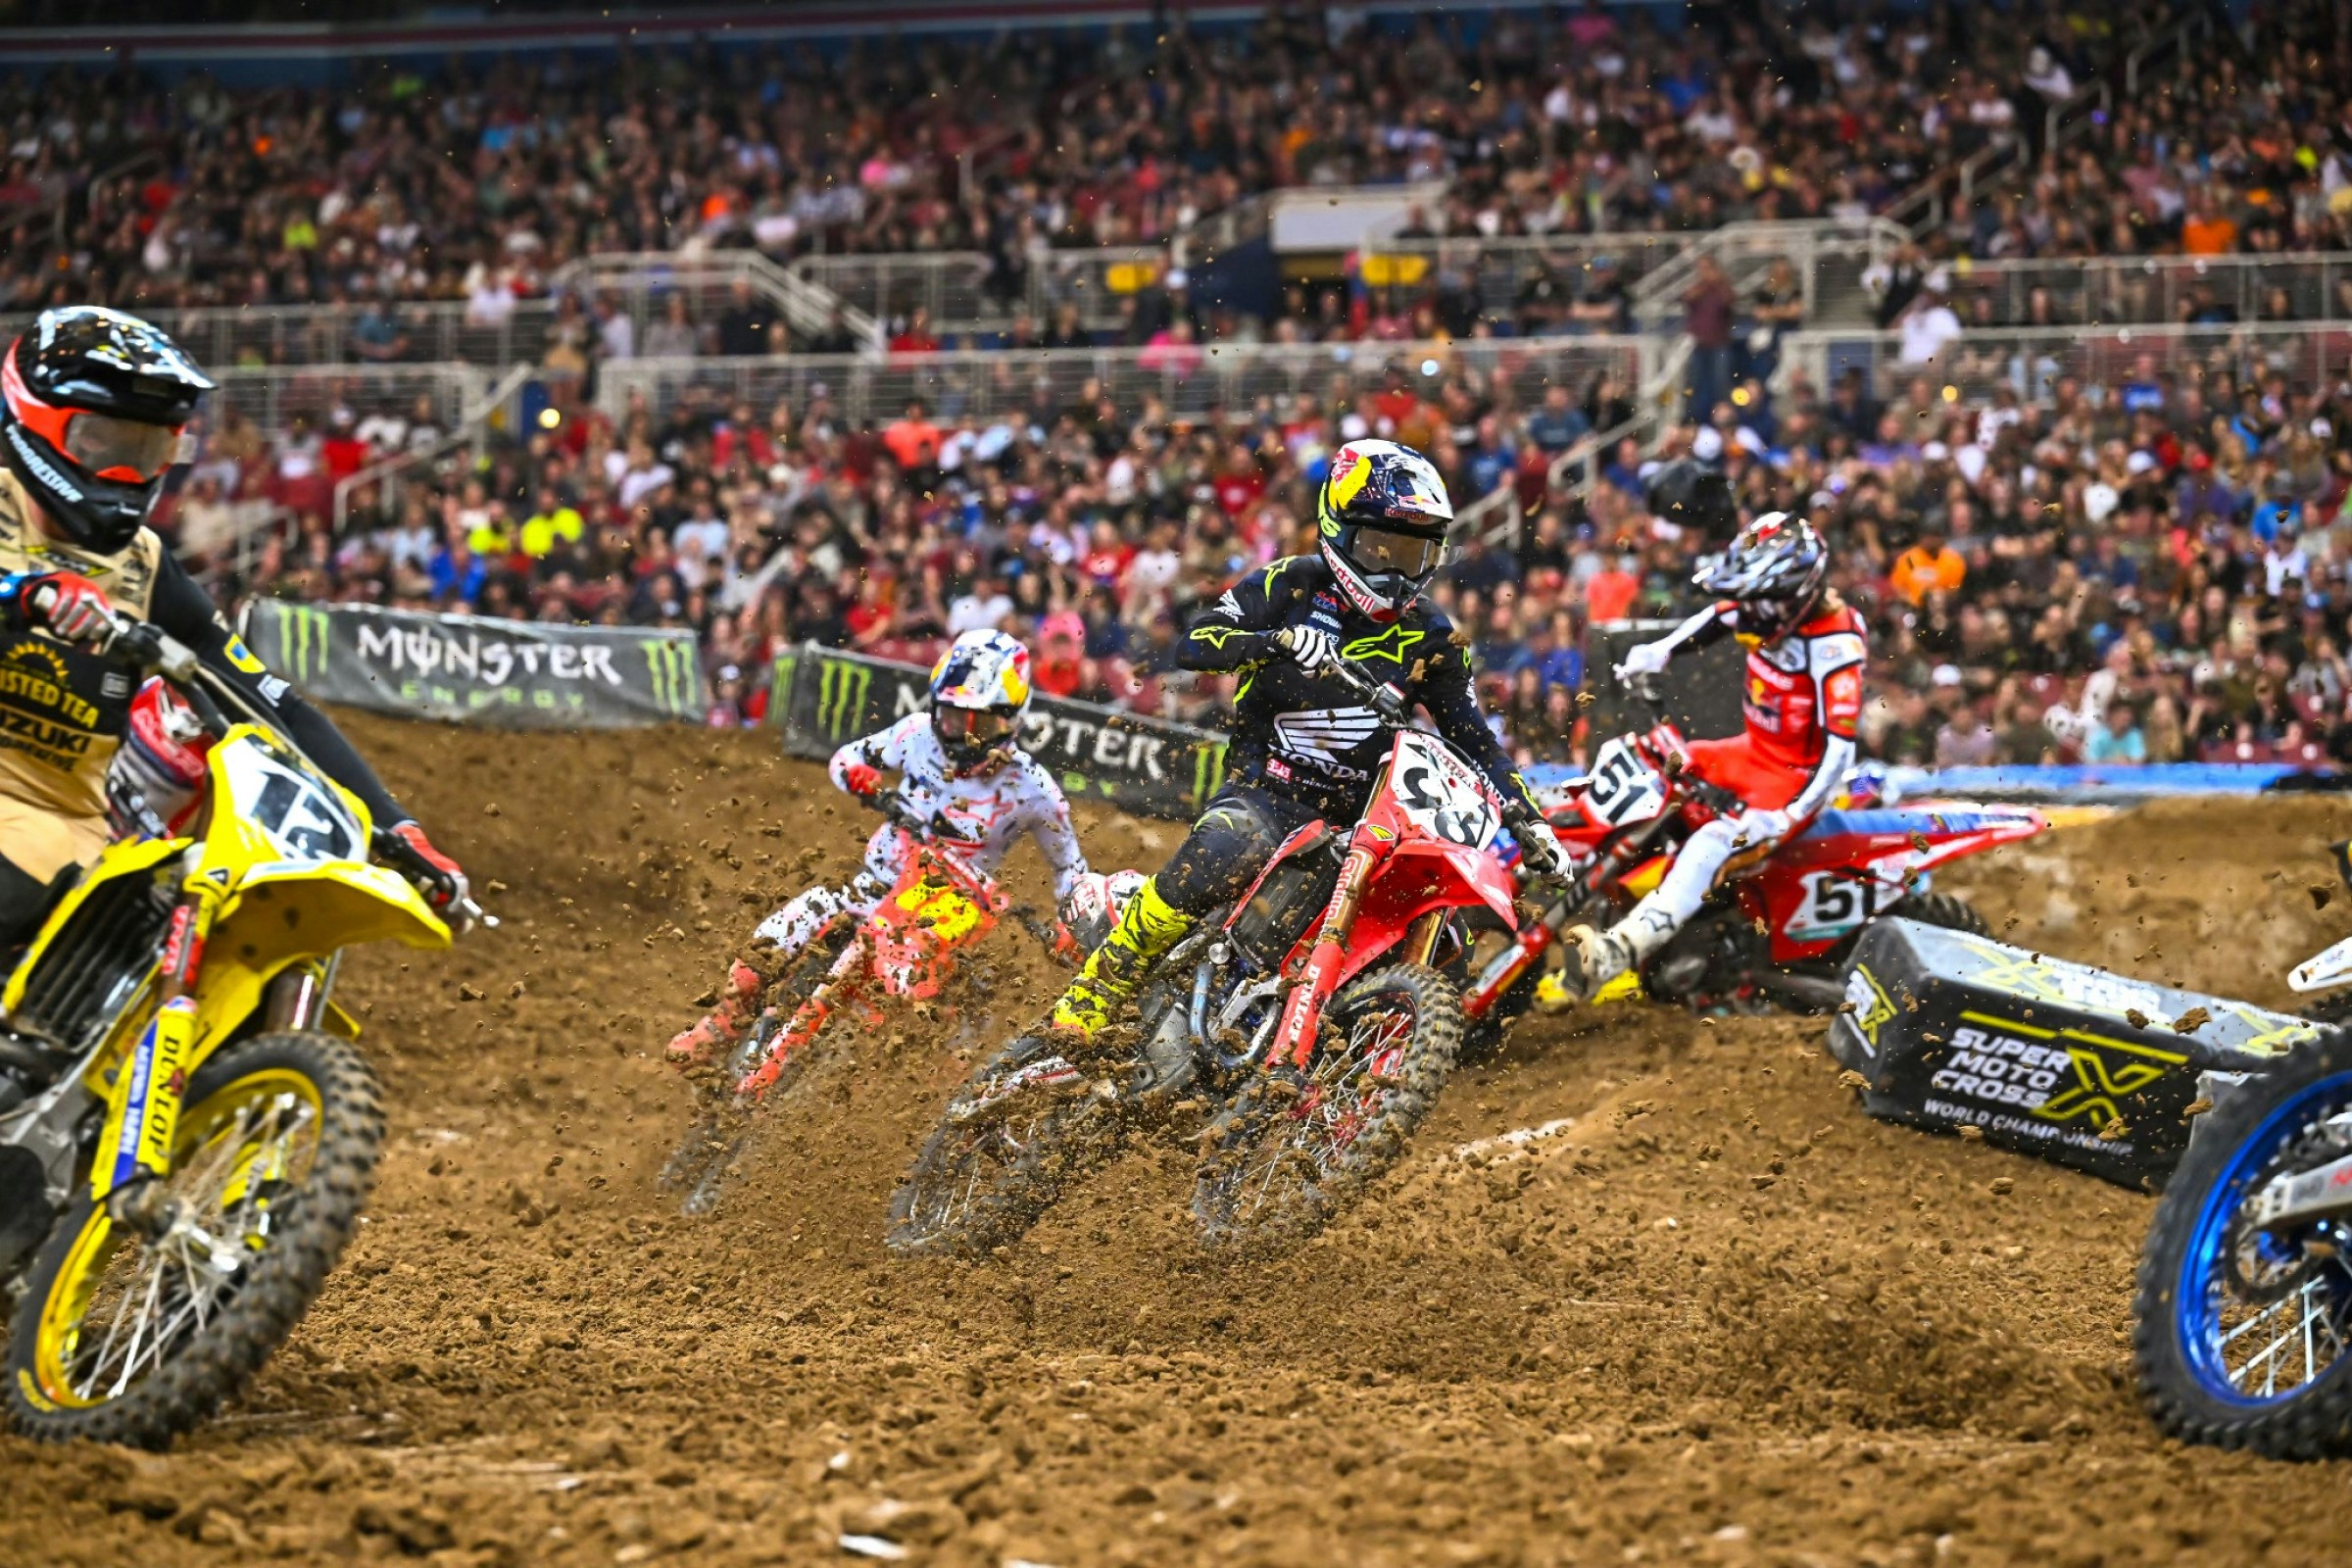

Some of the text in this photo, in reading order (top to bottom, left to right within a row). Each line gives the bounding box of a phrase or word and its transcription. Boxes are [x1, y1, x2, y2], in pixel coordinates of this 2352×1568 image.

[358, 622, 622, 686] MONSTER
[0, 712, 92, 755] ZUKI
[61, 691, 100, 729] TEA
[894, 682, 1164, 781] MSTER
[1589, 751, 1648, 824] 51
[1814, 869, 1877, 923] 51
[1946, 1050, 2058, 1090] MOTO
[1949, 1027, 2072, 1074] SUPER
[1931, 1069, 2050, 1108] CROSS
[1924, 1098, 2134, 1156] WORLD CHAMPONSHIP
